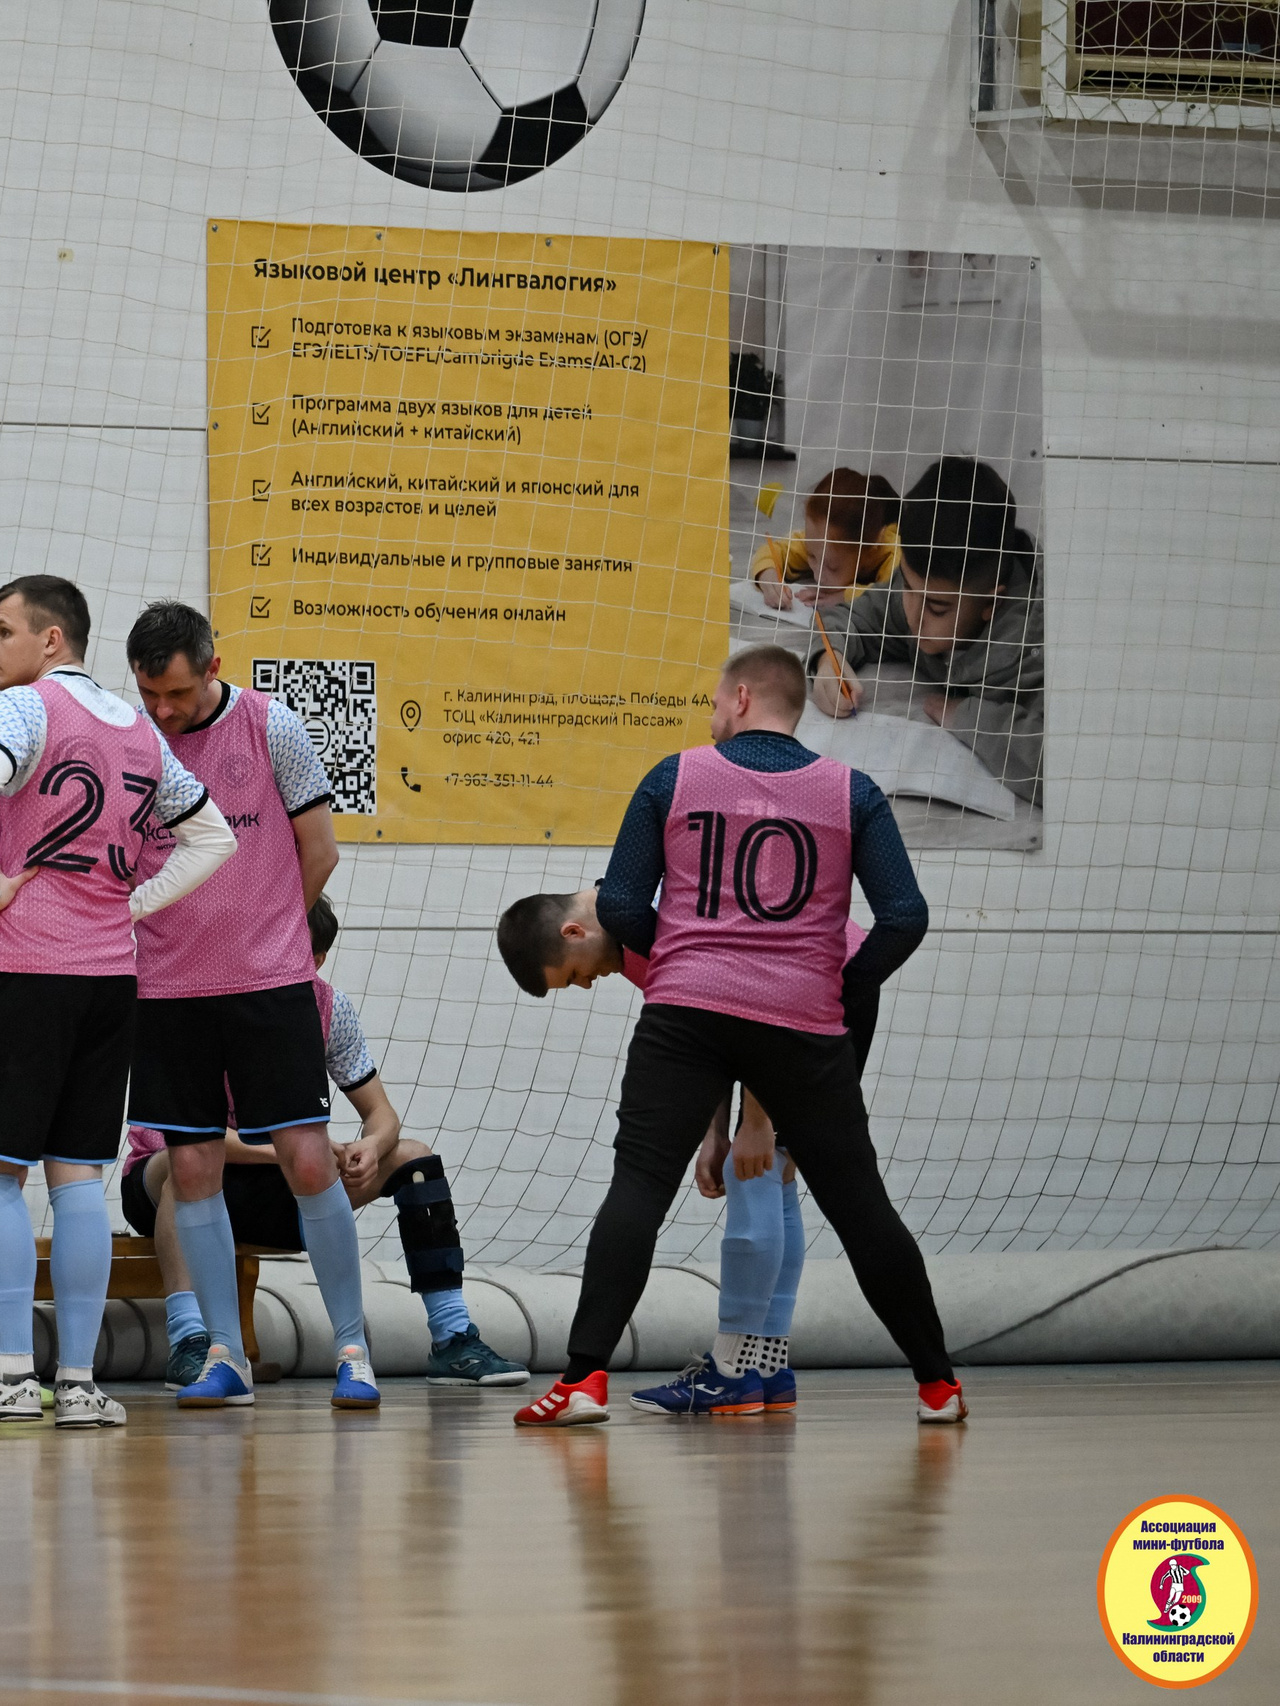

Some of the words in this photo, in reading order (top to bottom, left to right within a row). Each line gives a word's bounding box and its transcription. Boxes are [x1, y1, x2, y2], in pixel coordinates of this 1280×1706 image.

[254, 258, 367, 282] Языковой
[374, 267, 441, 290] центр
[447, 267, 617, 292] «Лингвалогия»
[292, 317, 391, 337] Подготовка
[397, 325, 407, 337] к
[412, 325, 500, 341] языковым
[505, 328, 599, 345] экзаменам
[604, 329, 649, 350] (ОГЭ/
[292, 394, 392, 415] Программа
[397, 401, 437, 418] двух
[441, 402, 503, 416] языков
[507, 404, 539, 420] для
[543, 404, 593, 421] детей
[292, 418, 405, 438] (Английский
[410, 426, 419, 436] +
[424, 425, 521, 446] китайский)
[291, 471, 403, 493] Английский,
[408, 475, 500, 493] китайский
[506, 481, 516, 494] и
[521, 480, 604, 496] японский
[608, 484, 639, 499] для
[291, 498, 330, 512] всех
[335, 499, 423, 517] возрастов
[428, 503, 439, 516] и
[445, 501, 497, 518] целей
[292, 547, 446, 569] Индивидуальные
[451, 555, 461, 568] и
[467, 555, 560, 572] групповые
[564, 557, 633, 573] занятия
[293, 599, 410, 618] Возможность
[414, 602, 498, 622] обучения
[503, 605, 567, 622] онлайн
[443, 690, 453, 702] г.
[630, 691, 687, 708] Победы
[443, 709, 476, 726] ТОЦ
[479, 710, 618, 728] «Калининградский
[622, 712, 683, 727] Пассаж»
[443, 733, 482, 747] офис
[23, 759, 158, 881] 23
[687, 810, 818, 924] 10
